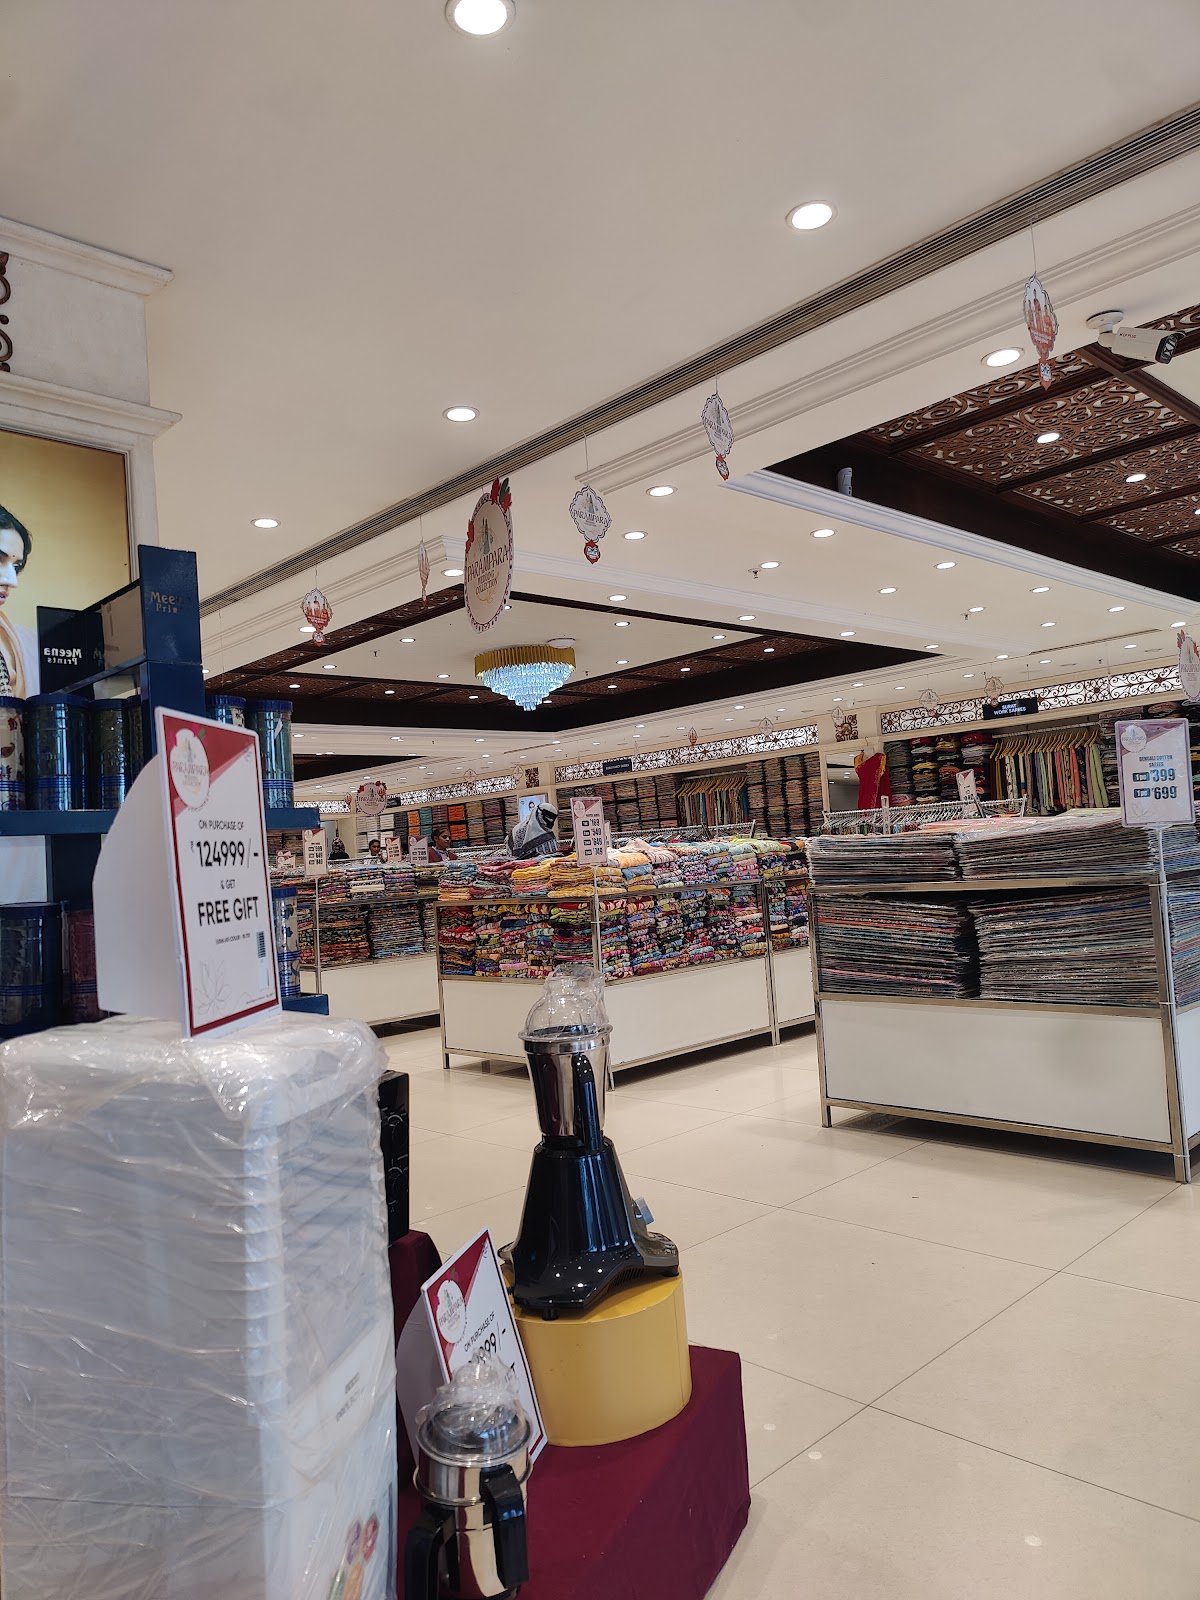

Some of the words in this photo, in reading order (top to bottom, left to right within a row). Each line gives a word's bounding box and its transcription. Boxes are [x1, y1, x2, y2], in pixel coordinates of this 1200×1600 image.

[467, 544, 510, 583] PARAMPARA
[198, 820, 207, 829] ON
[208, 820, 237, 831] PURCHASE
[237, 821, 244, 831] OF
[197, 899, 231, 927] FREE
[233, 896, 259, 921] GIFT
[471, 1317, 490, 1345] PURCHASE
[489, 1310, 495, 1322] OF
